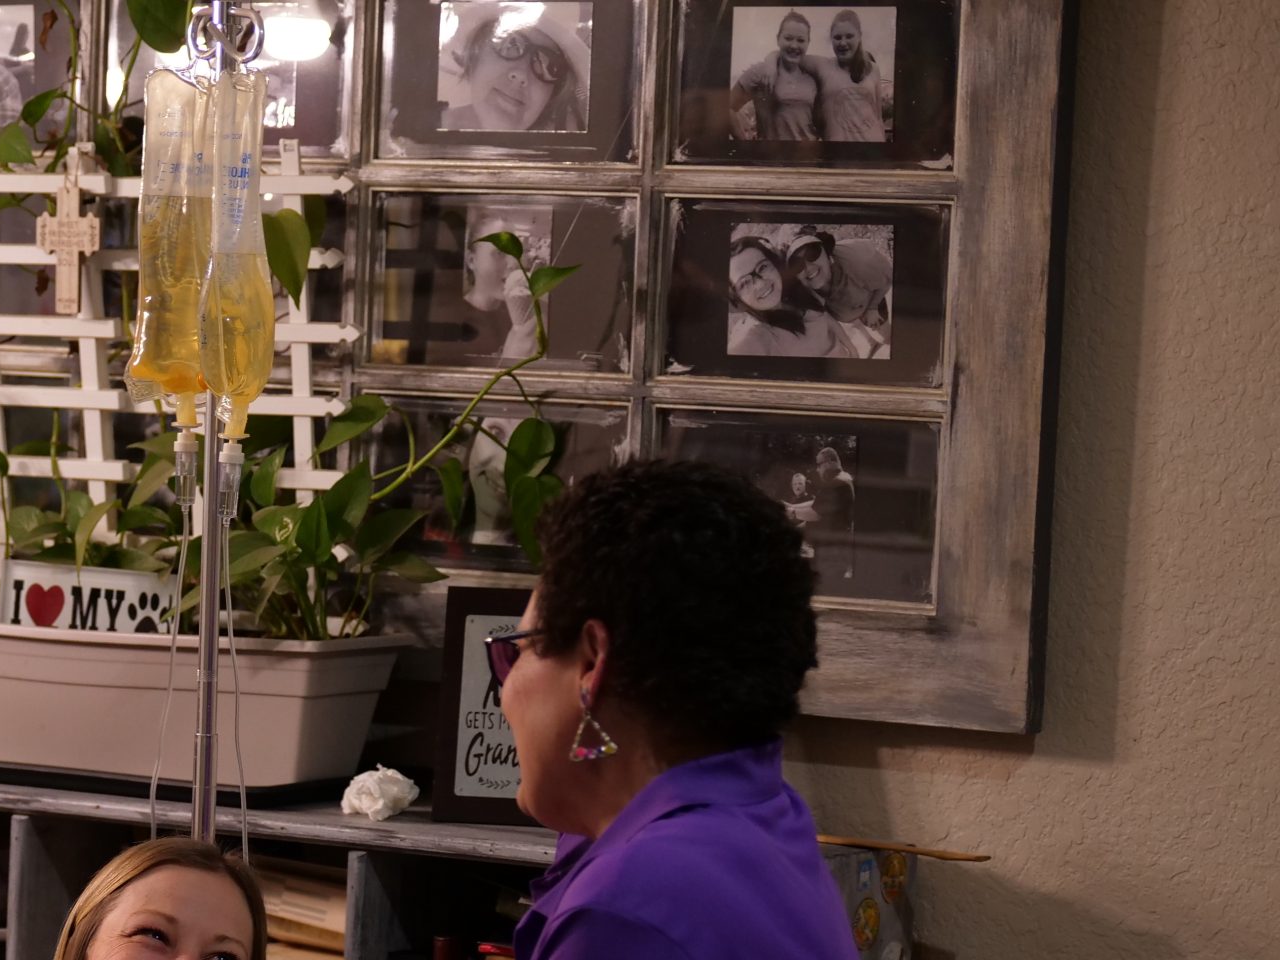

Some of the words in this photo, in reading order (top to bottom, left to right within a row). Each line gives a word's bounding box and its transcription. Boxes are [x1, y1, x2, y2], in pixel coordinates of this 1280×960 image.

[11, 579, 24, 625] I
[69, 586, 125, 632] MY
[465, 711, 495, 730] GETS
[464, 731, 520, 777] Gran
